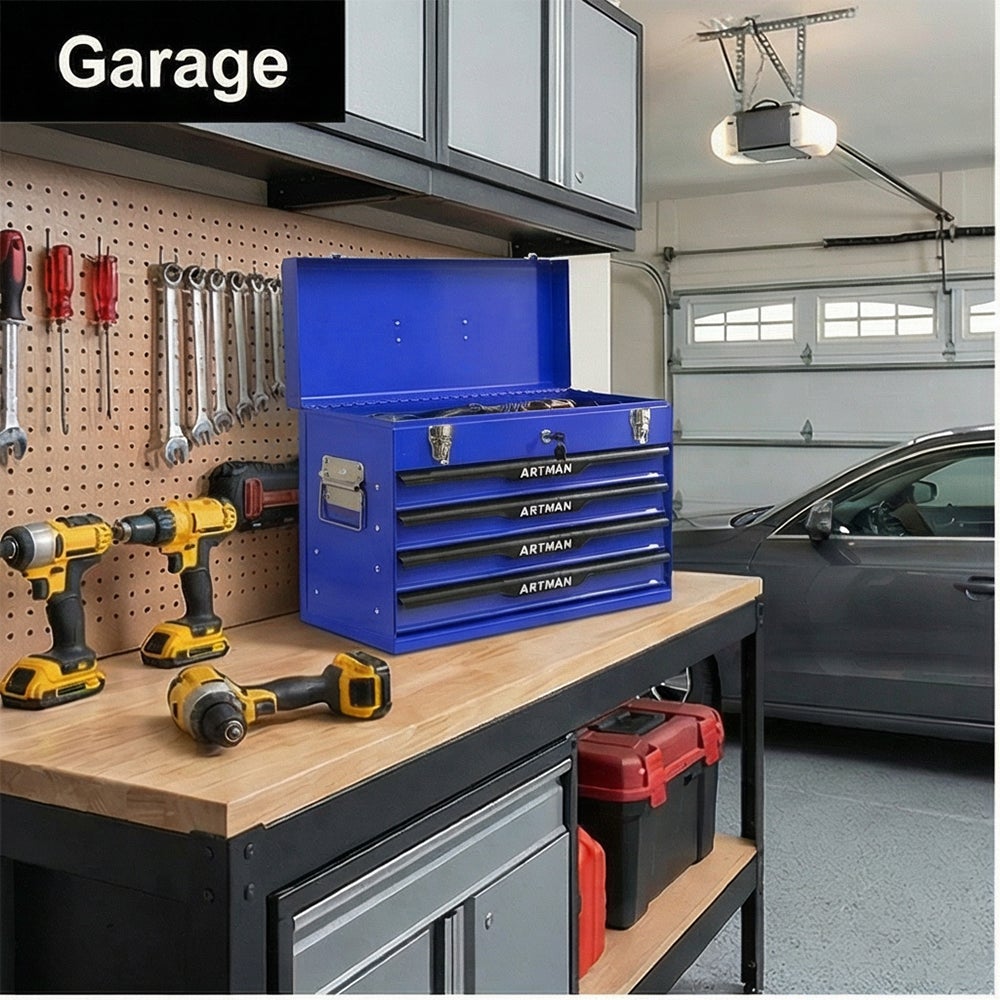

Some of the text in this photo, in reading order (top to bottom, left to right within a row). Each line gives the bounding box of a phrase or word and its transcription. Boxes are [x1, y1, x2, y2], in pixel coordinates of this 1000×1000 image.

[519, 462, 573, 479] ARTMAN
[519, 500, 573, 518] ARTMAN
[519, 538, 573, 556] ARTMAN
[519, 576, 573, 594] ARTMAN
